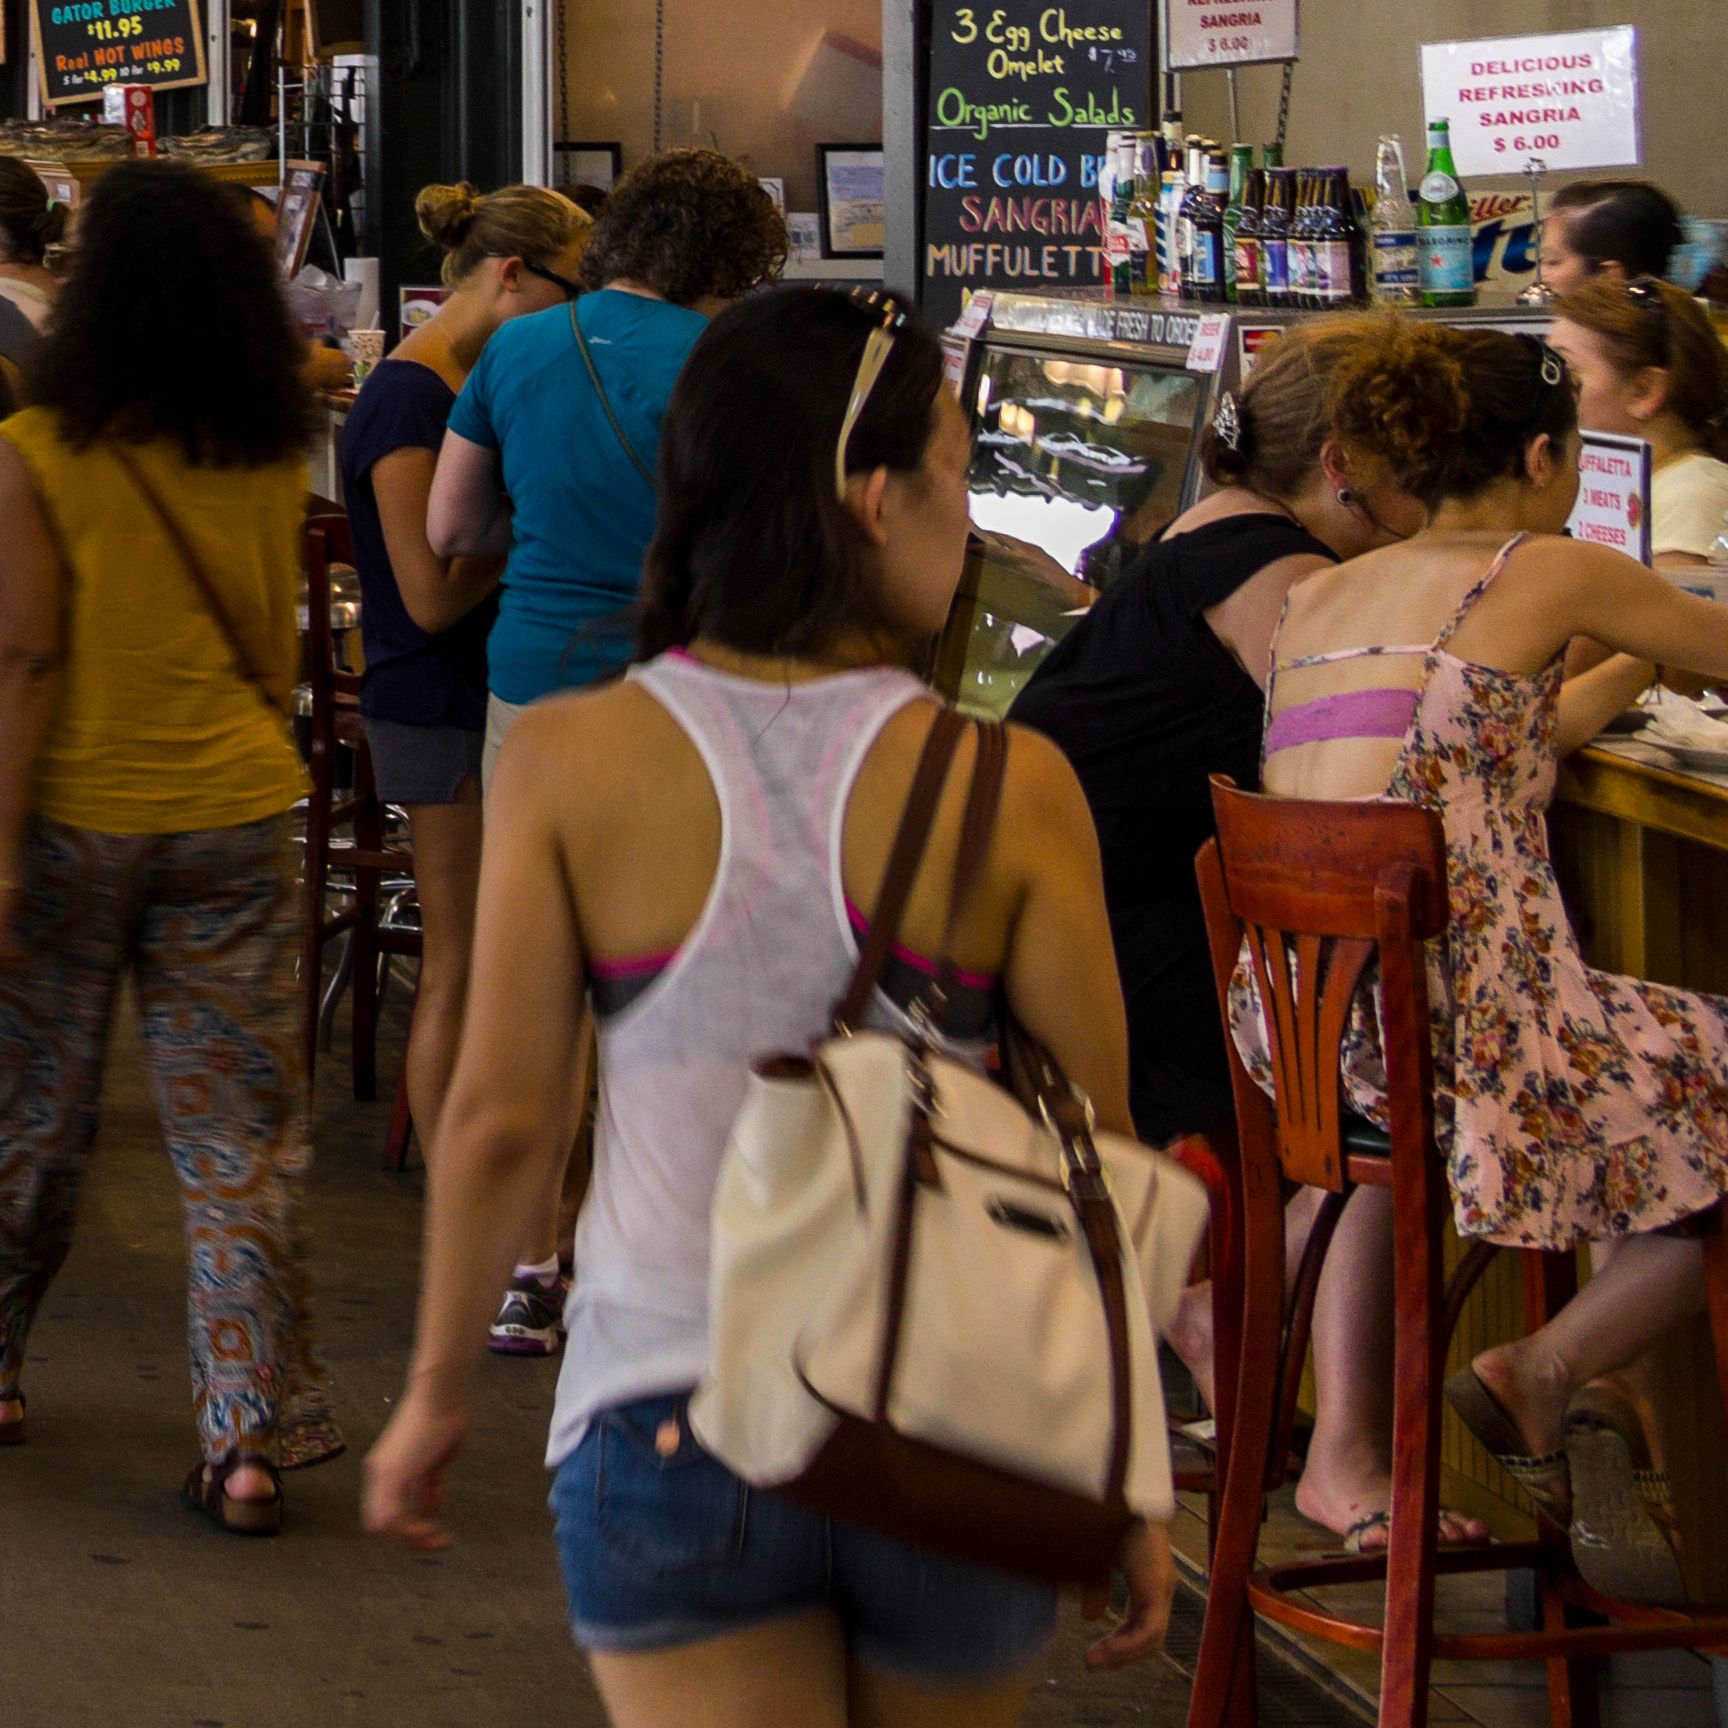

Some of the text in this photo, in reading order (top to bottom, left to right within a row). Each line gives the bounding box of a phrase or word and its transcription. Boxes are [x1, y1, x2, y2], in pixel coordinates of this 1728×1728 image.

[51, 2, 104, 24] GATOR
[1200, 12, 1262, 29] SANGRIA
[87, 16, 143, 40] $11.95
[951, 8, 1123, 52] 3 Egg Cheese
[55, 37, 185, 72] Real HOT WINGS
[147, 58, 181, 74] $9.99
[987, 49, 1065, 82] Omelet
[1471, 54, 1592, 76] DELICIOUS
[937, 86, 1135, 140] Organic Salads
[1480, 107, 1581, 127] SANGRIA
[1494, 134, 1560, 152] $ 6.00
[929, 153, 1067, 189] ICE COLD
[959, 195, 1103, 236] SANGRIA
[926, 243, 1104, 278] MUFFULETT
[1116, 311, 1149, 341] FRESH
[1151, 313, 1164, 342] TO
[1578, 453, 1631, 477] UFFALETTA
[1590, 489, 1621, 510] MEATS
[1586, 523, 1627, 546] CHEESES
